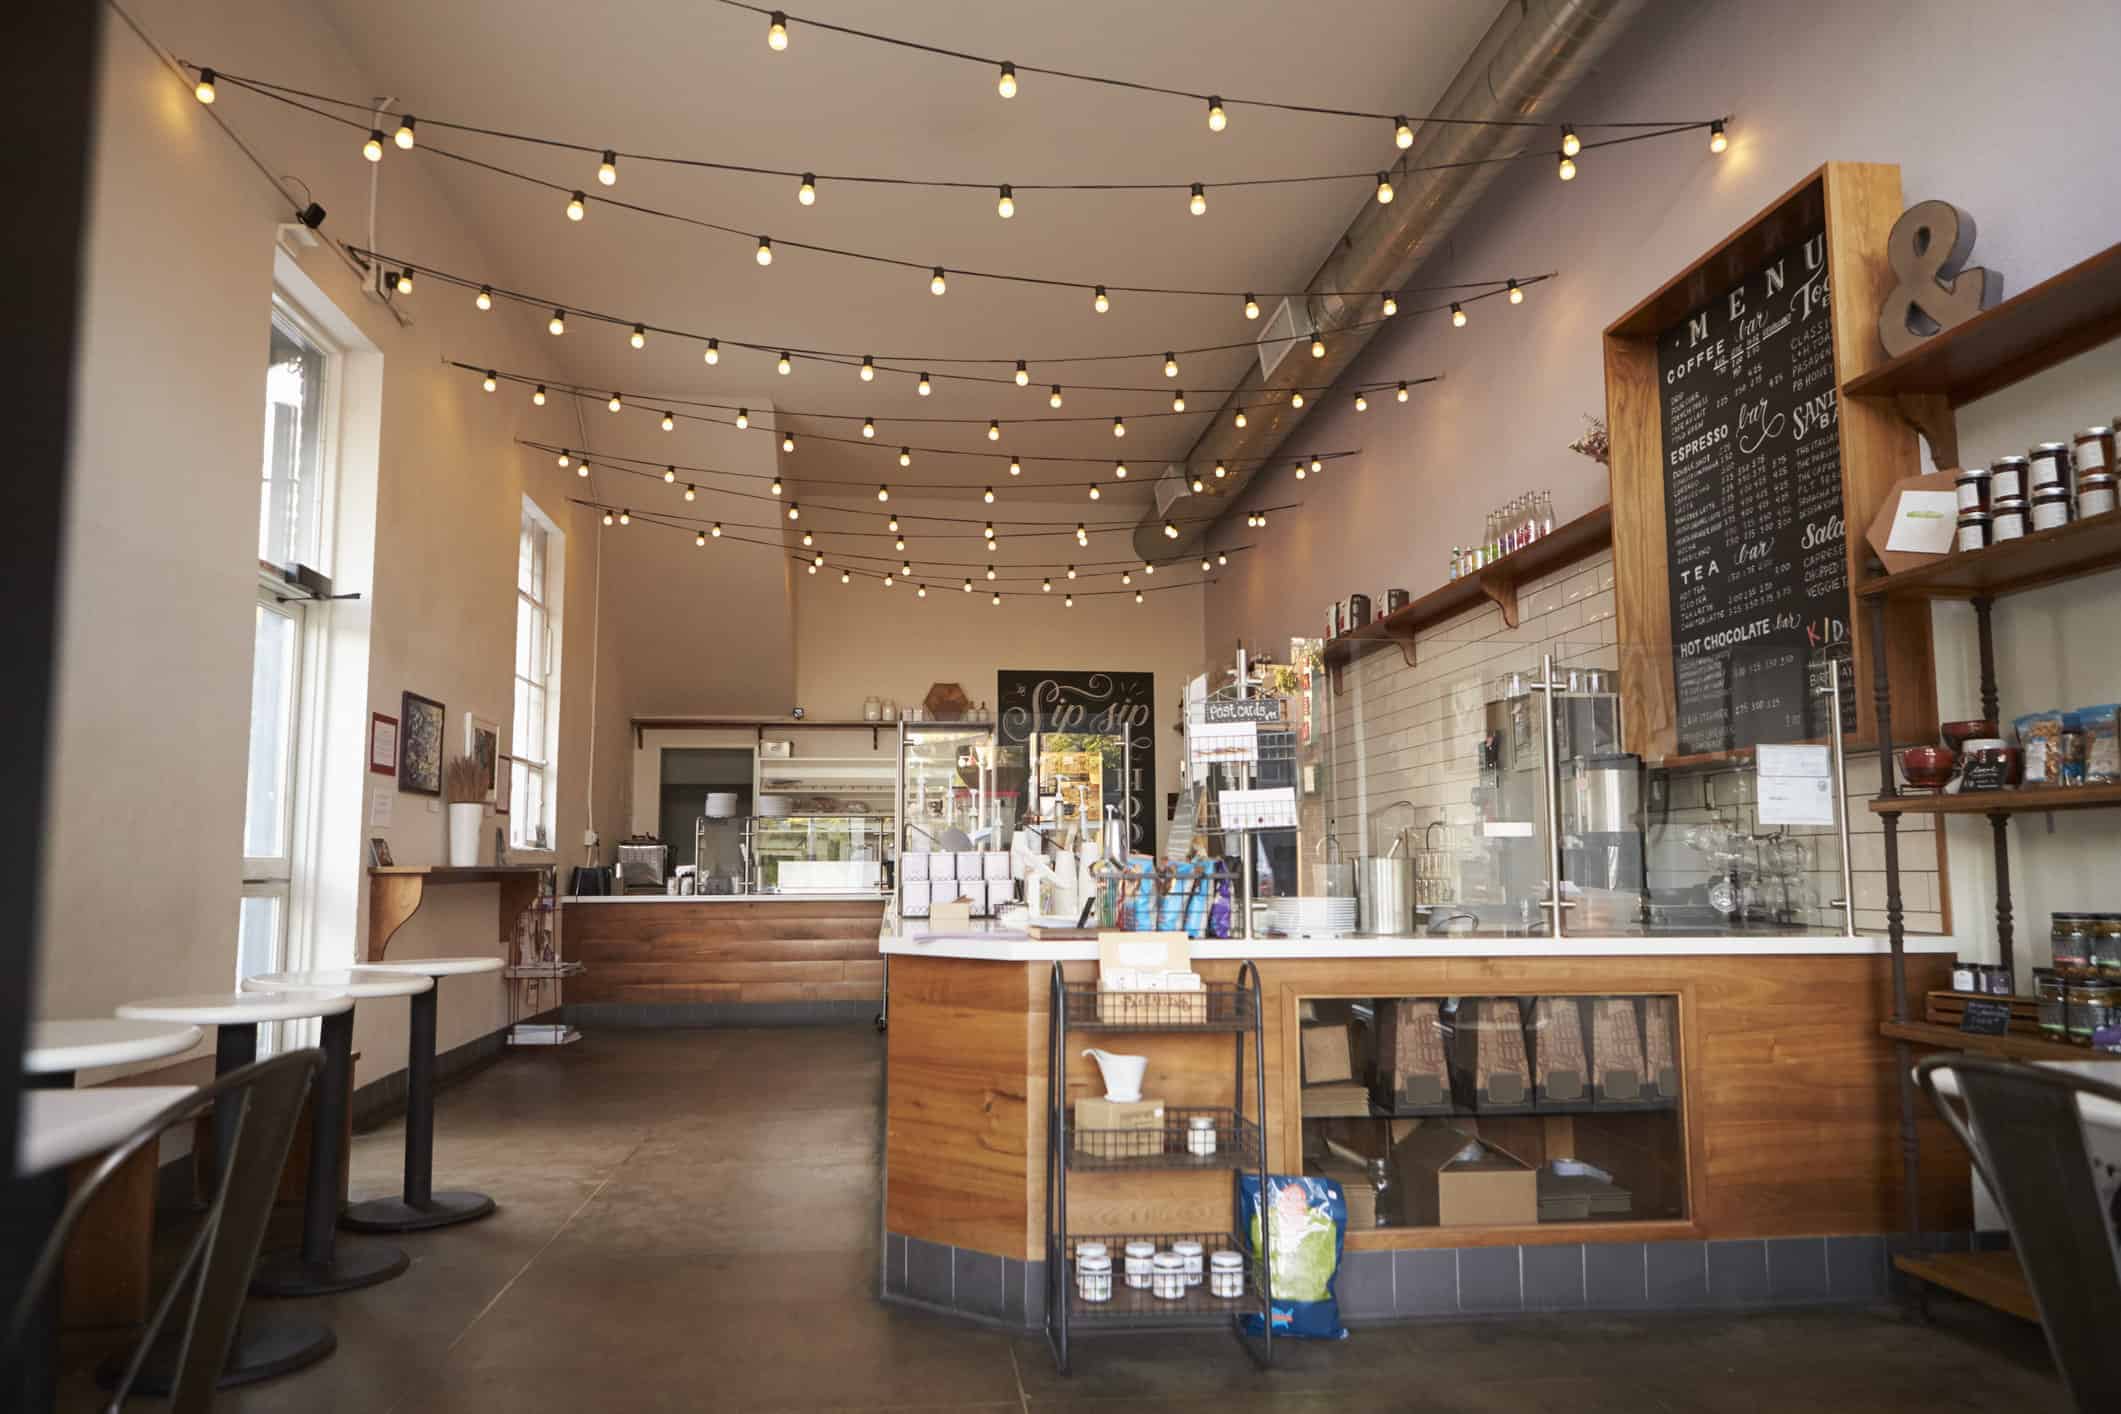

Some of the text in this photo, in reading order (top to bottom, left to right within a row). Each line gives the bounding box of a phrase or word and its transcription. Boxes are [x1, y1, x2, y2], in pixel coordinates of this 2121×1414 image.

[1688, 232, 1824, 348] MENU
[1667, 339, 1725, 384] COFFEE
[1738, 311, 1768, 341] bar
[1671, 424, 1728, 465] ESPRESSO
[1681, 560, 1719, 585] TEA
[1735, 537, 1774, 565] bar
[1680, 639, 1701, 659] HOT
[1703, 618, 1771, 651] CHOCOLATE
[1003, 680, 1150, 741] Sip sip
